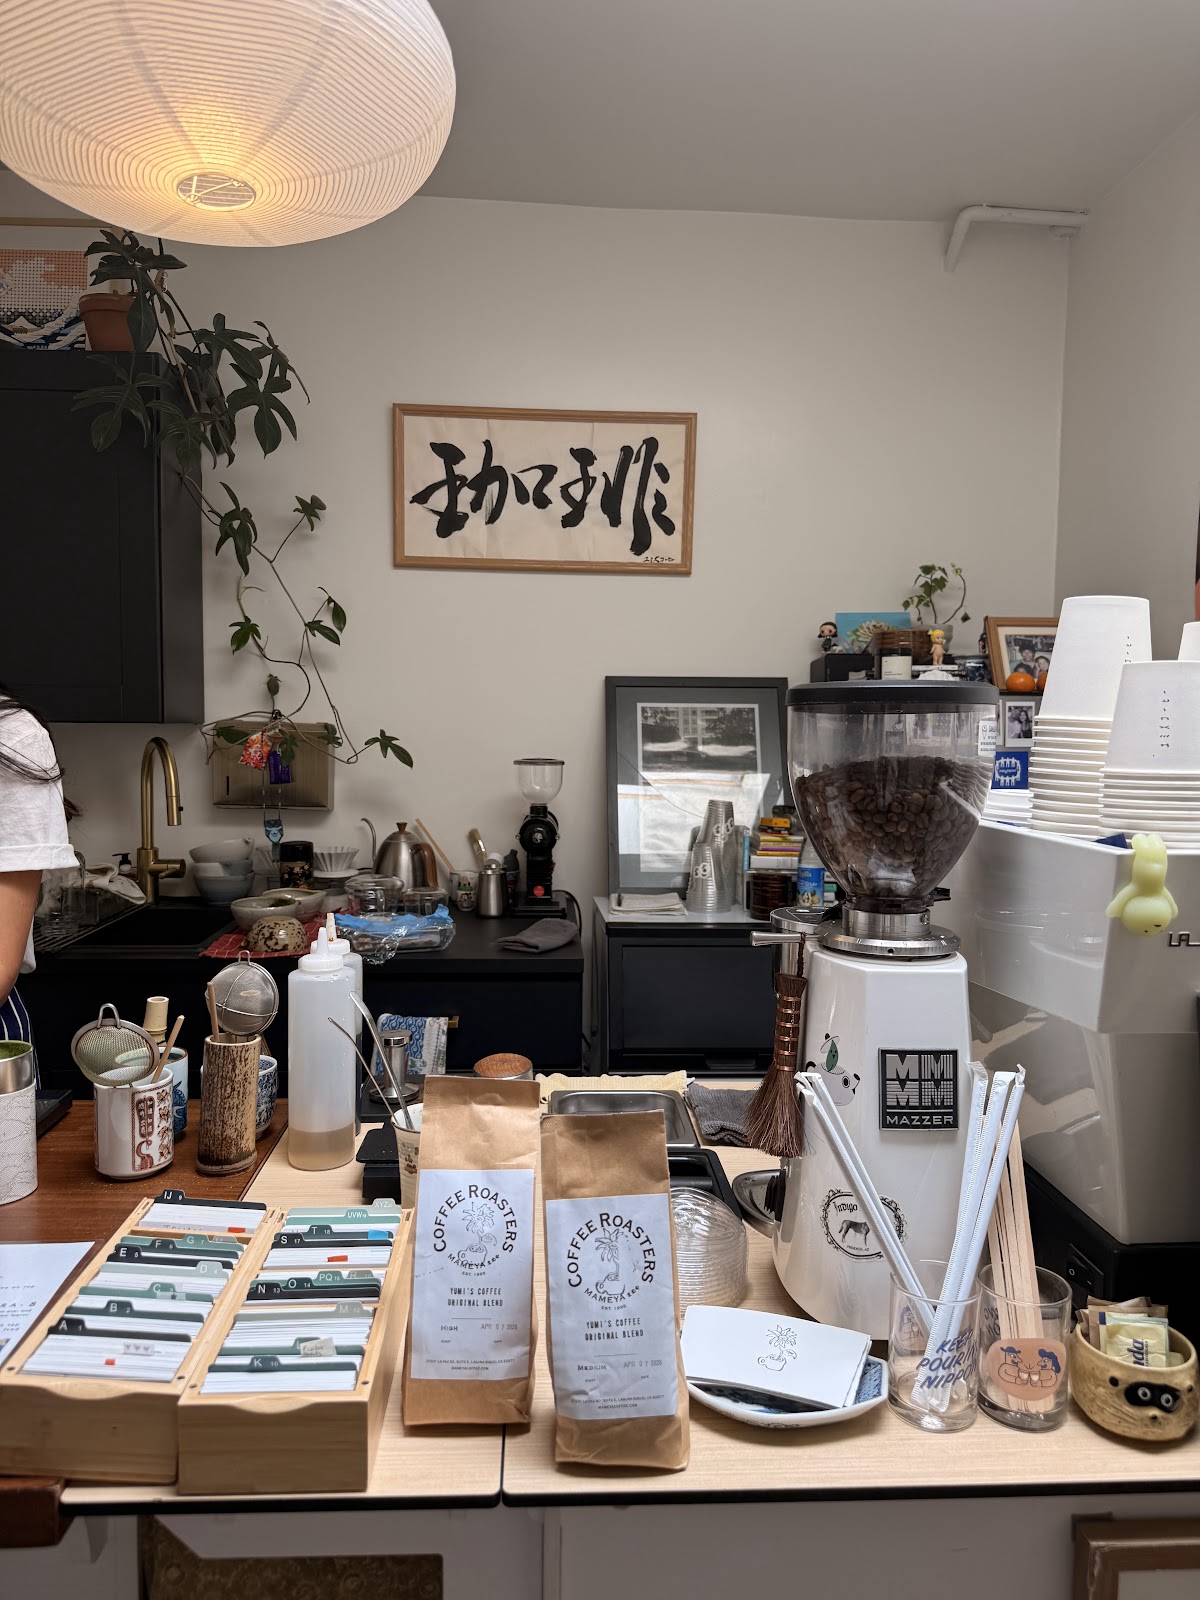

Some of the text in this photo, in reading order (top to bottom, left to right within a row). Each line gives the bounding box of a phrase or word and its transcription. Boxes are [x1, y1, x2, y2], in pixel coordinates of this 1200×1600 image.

[886, 1115, 954, 1125] MAZZER
[163, 1190, 173, 1199] IJ
[433, 1184, 518, 1253] COFFEE ROASTERS
[311, 1226, 318, 1235] T
[155, 1239, 162, 1248] F
[186, 1235, 195, 1244] G
[280, 1235, 288, 1244] S
[119, 1247, 127, 1257] E
[567, 1212, 656, 1288] COFFEE ROASTERS
[447, 1253, 486, 1270] MAMEYA
[199, 1264, 208, 1273] D
[319, 1273, 333, 1282] PQ
[152, 1283, 161, 1293] C
[287, 1278, 297, 1289] O
[257, 1284, 266, 1294] N
[450, 1287, 502, 1295] YUMI'S COFFEE
[584, 1288, 626, 1304] MAMEYA
[109, 1302, 118, 1313] B
[447, 1298, 504, 1307] ORIGINAL BLEND
[339, 1304, 349, 1314] M
[58, 1319, 68, 1330] A
[586, 1317, 641, 1329] YUMI'S COFFEE
[585, 1329, 644, 1341] ORIGINAL BLEND
[253, 1358, 263, 1367] K
